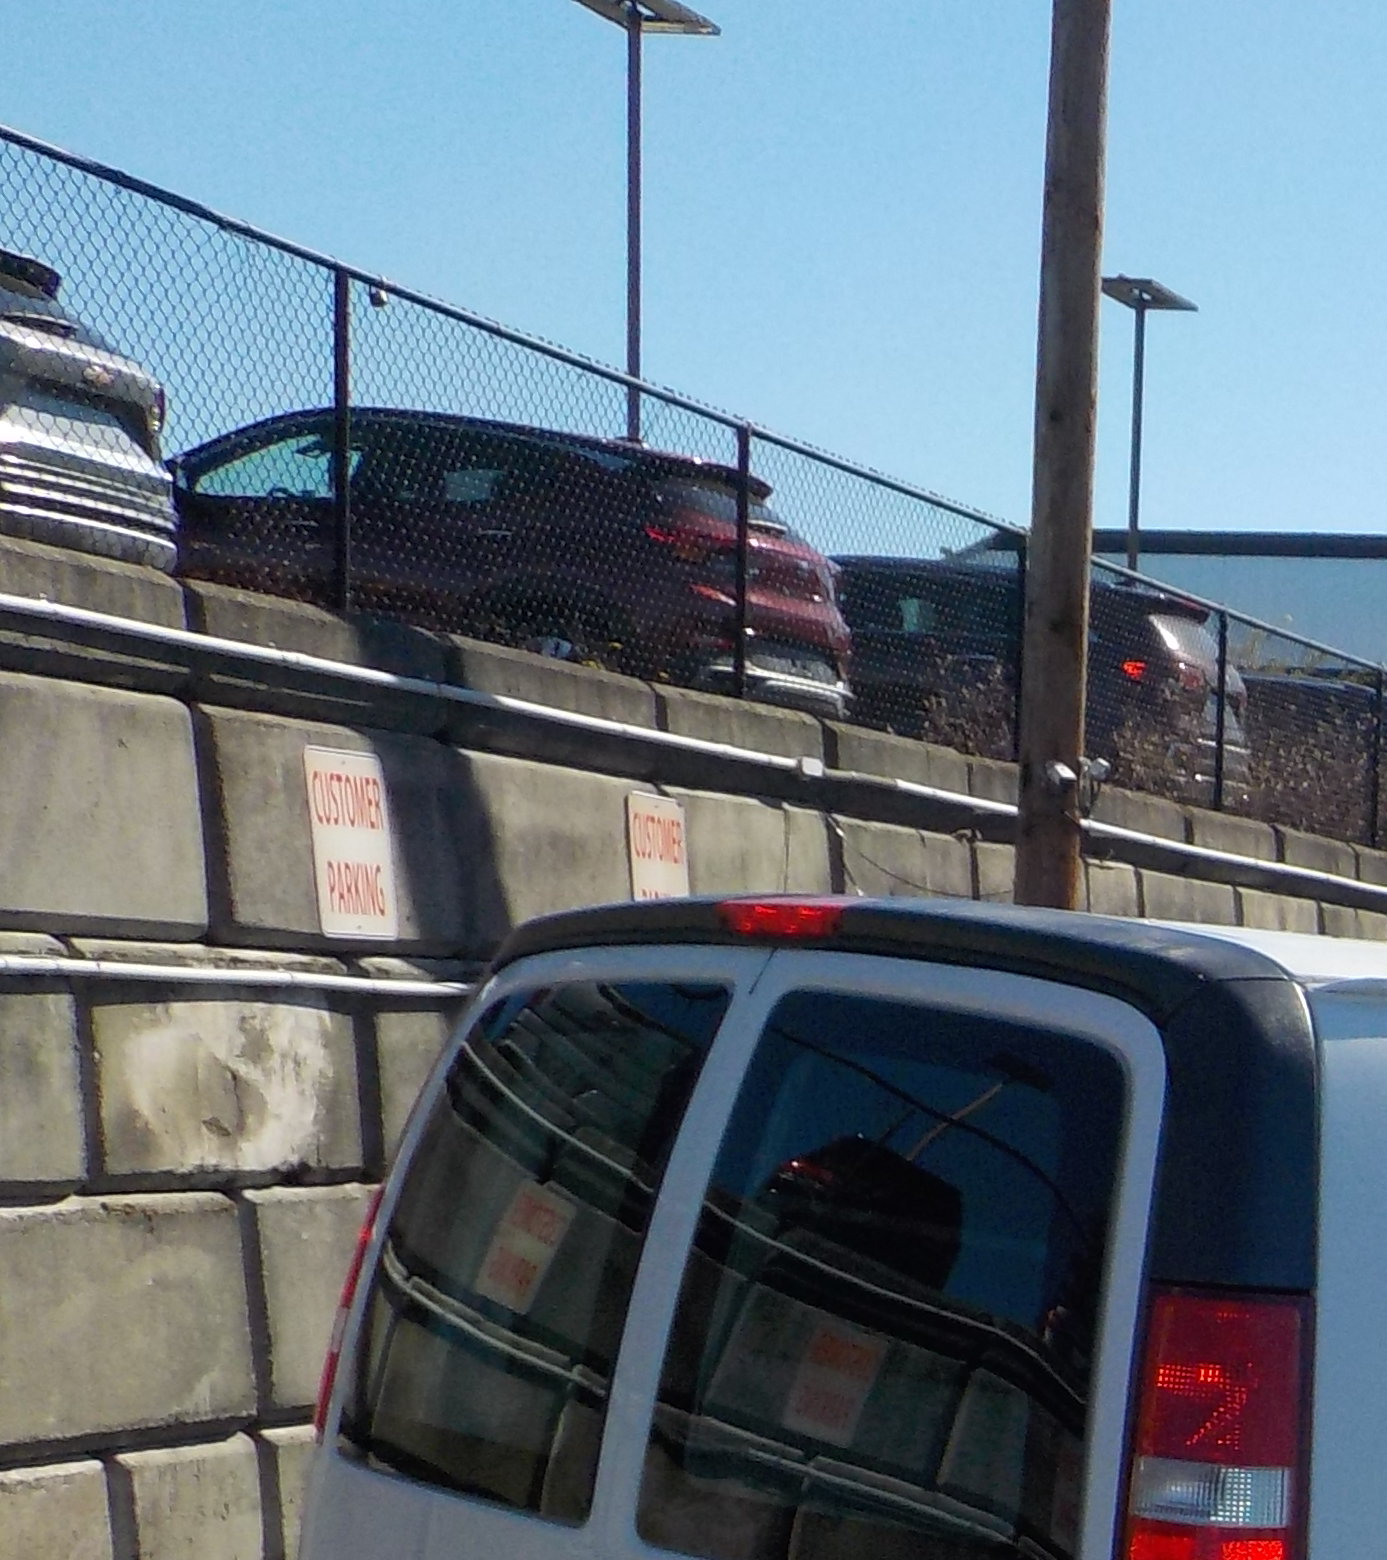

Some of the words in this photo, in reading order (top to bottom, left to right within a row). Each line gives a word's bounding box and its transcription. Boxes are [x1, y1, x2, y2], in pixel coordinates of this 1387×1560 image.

[311, 769, 384, 831] CUSTOMER
[632, 811, 684, 865] CUSTOMER
[326, 860, 386, 918] PARKING
